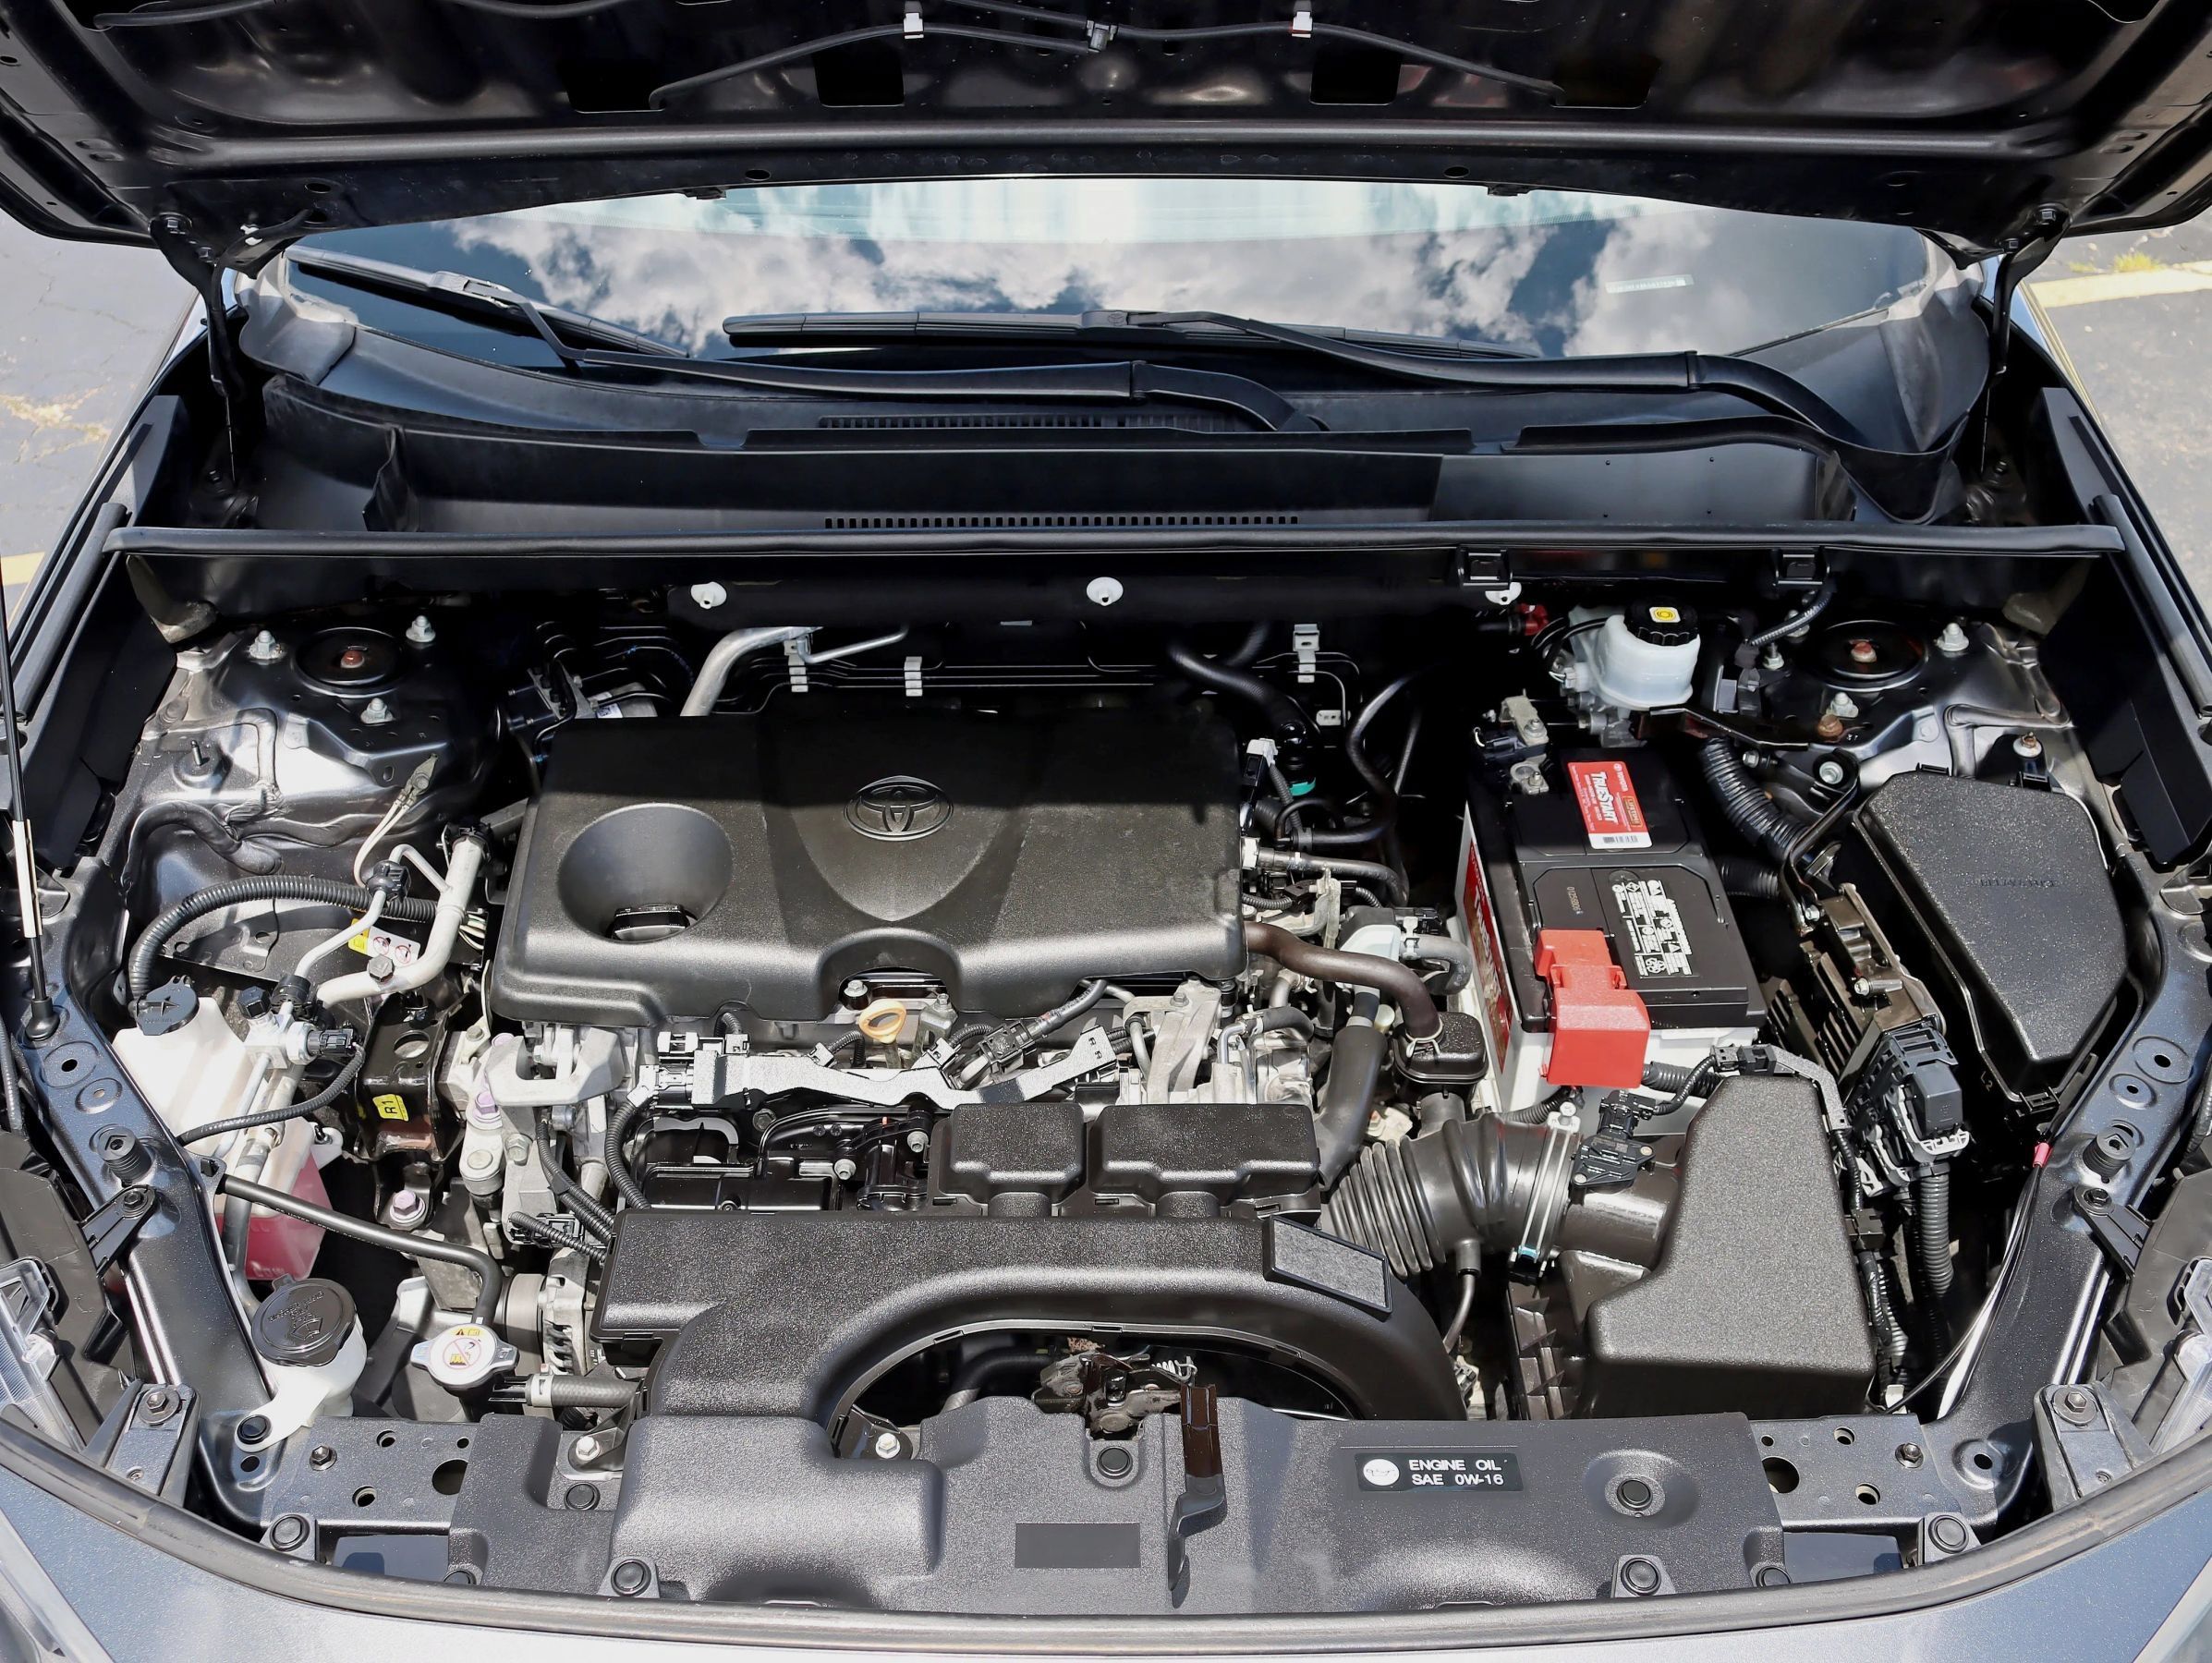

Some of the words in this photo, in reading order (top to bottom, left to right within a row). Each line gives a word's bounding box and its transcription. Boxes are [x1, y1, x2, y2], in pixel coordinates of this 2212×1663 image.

[1408, 1459, 1466, 1471] ENGINE
[1475, 1459, 1502, 1471] OIL
[1411, 1474, 1445, 1486] SAE
[1454, 1474, 1504, 1486] 0W-16
